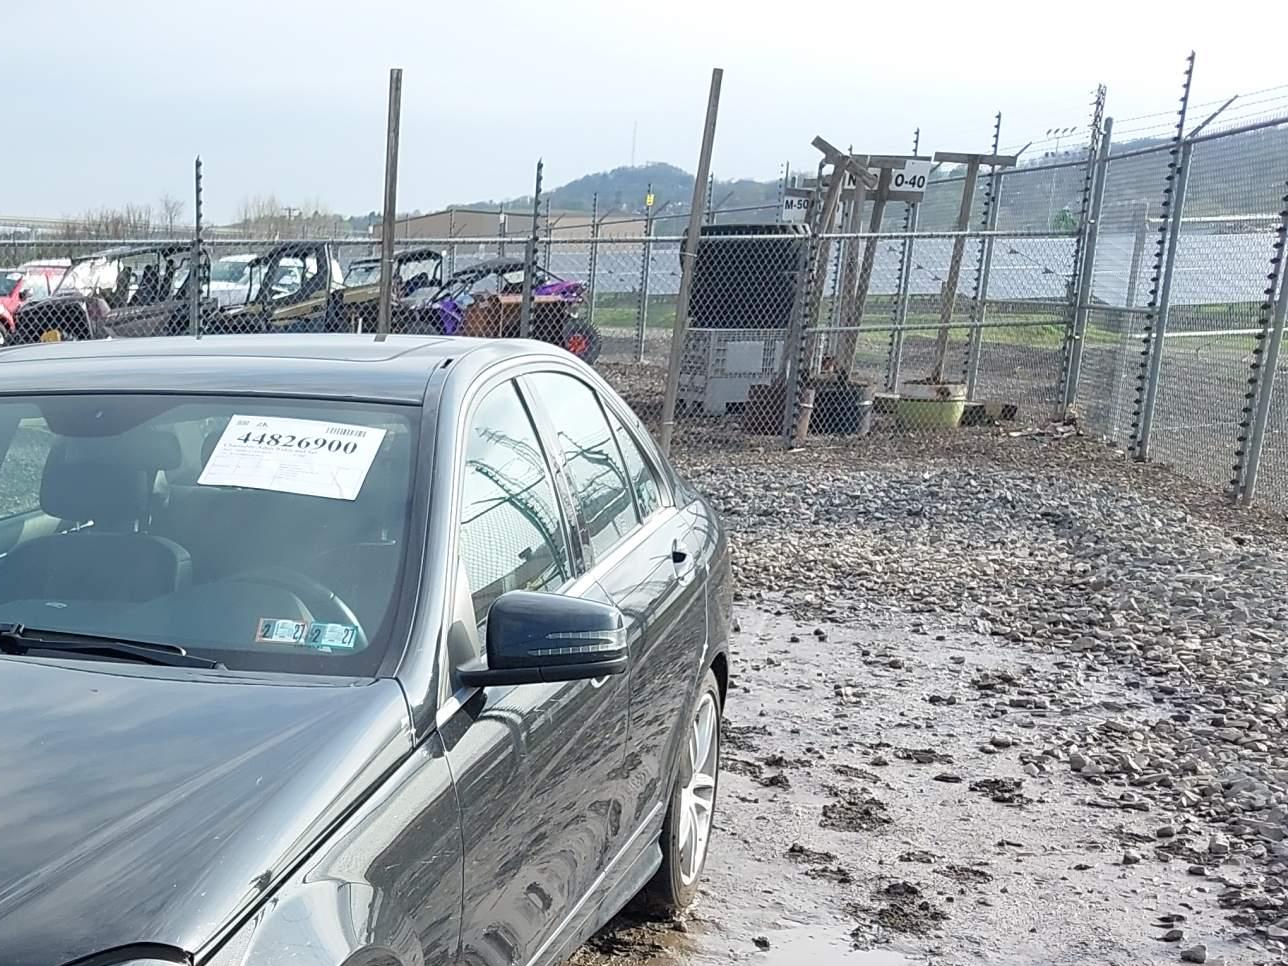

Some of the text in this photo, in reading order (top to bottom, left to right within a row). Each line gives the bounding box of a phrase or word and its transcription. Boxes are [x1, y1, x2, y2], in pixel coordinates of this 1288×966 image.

[894, 173, 926, 188] O-40
[785, 199, 810, 210] M-50
[237, 431, 358, 454] 44826900
[262, 623, 306, 641] 2 27
[312, 628, 356, 646] 2 27
